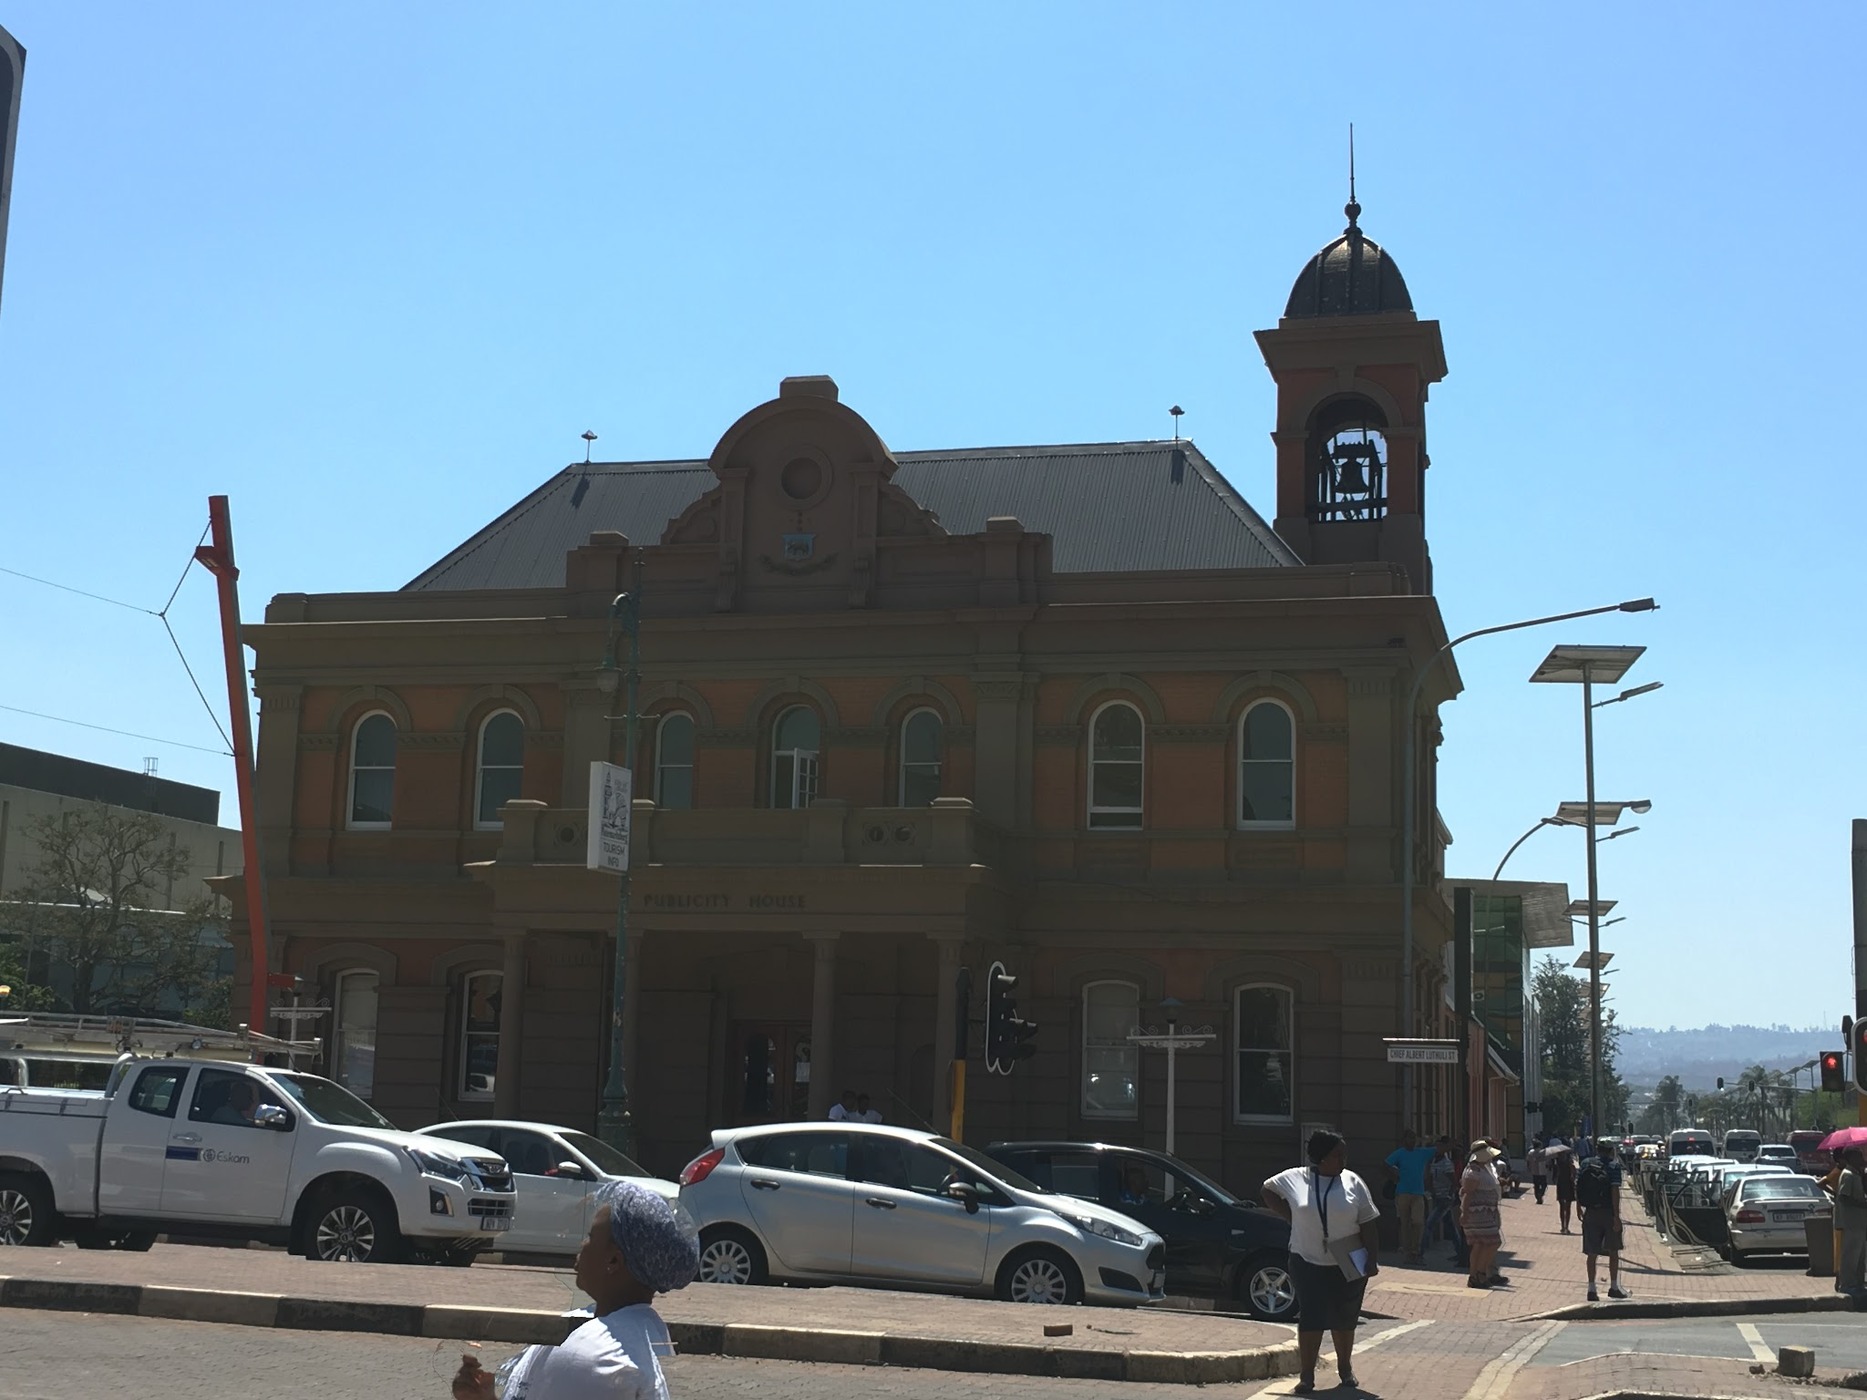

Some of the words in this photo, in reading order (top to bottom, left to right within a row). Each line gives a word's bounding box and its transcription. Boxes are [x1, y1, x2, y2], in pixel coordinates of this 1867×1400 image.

[603, 841, 625, 856] TOURISM
[607, 855, 619, 867] INFO
[643, 893, 729, 908] PUBLICITY
[749, 893, 806, 908] HOUSE
[1390, 1049, 1405, 1058] CHIEF
[1406, 1050, 1425, 1059] ALBERT
[1426, 1050, 1448, 1060] LUTHULI
[1448, 1051, 1456, 1060] ST
[216, 1151, 250, 1164] Eskom
